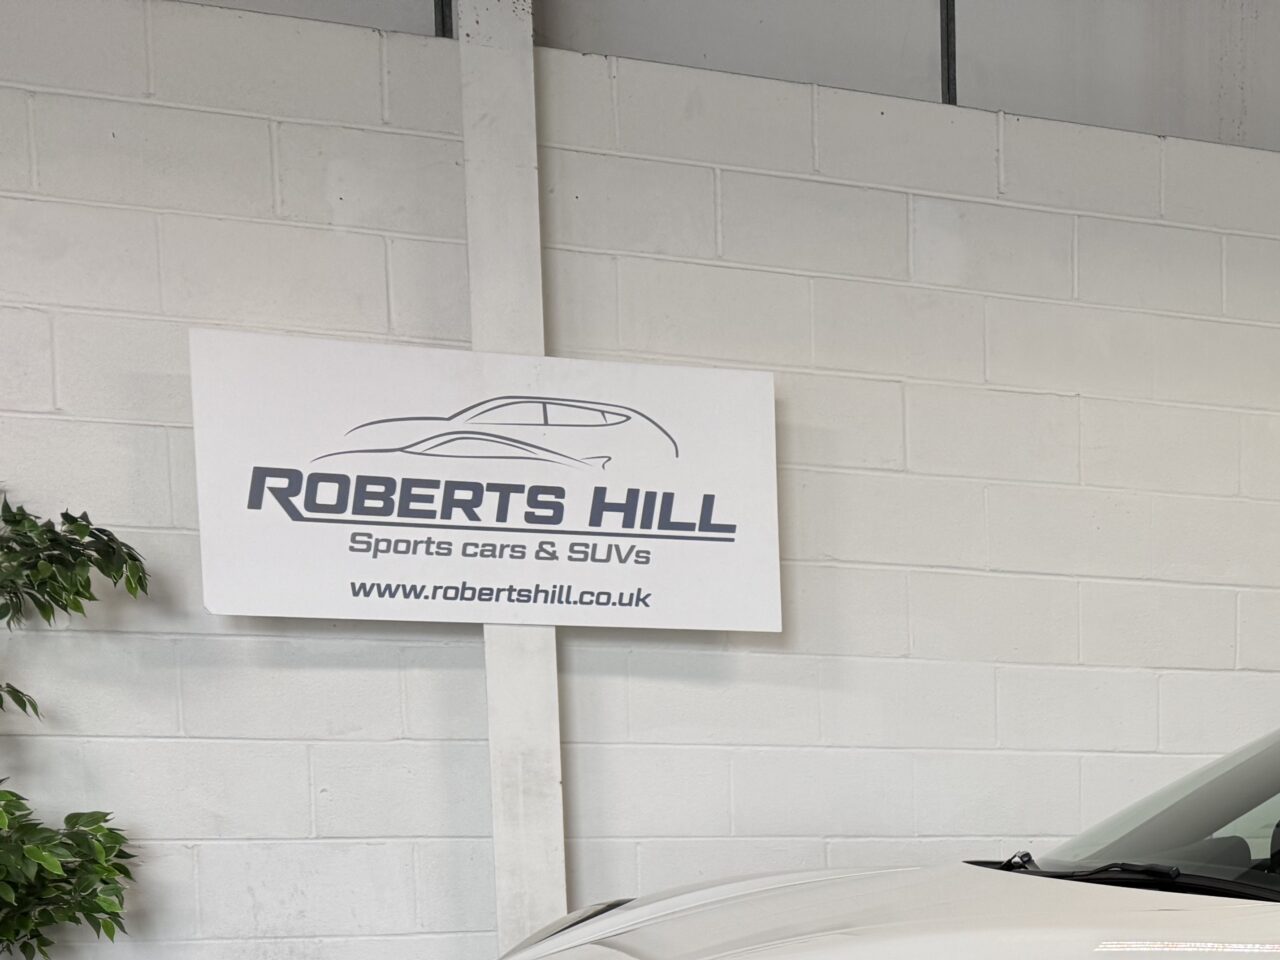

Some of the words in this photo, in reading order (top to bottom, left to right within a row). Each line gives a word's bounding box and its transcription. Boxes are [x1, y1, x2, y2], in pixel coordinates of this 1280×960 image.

[247, 466, 566, 525] ROBERTS
[588, 487, 737, 534] HILL
[348, 532, 453, 558] Sports
[461, 542, 527, 560] cars
[534, 540, 559, 561] &
[567, 542, 651, 565] SUVs
[350, 581, 652, 608] www.robertshill.co.uk
